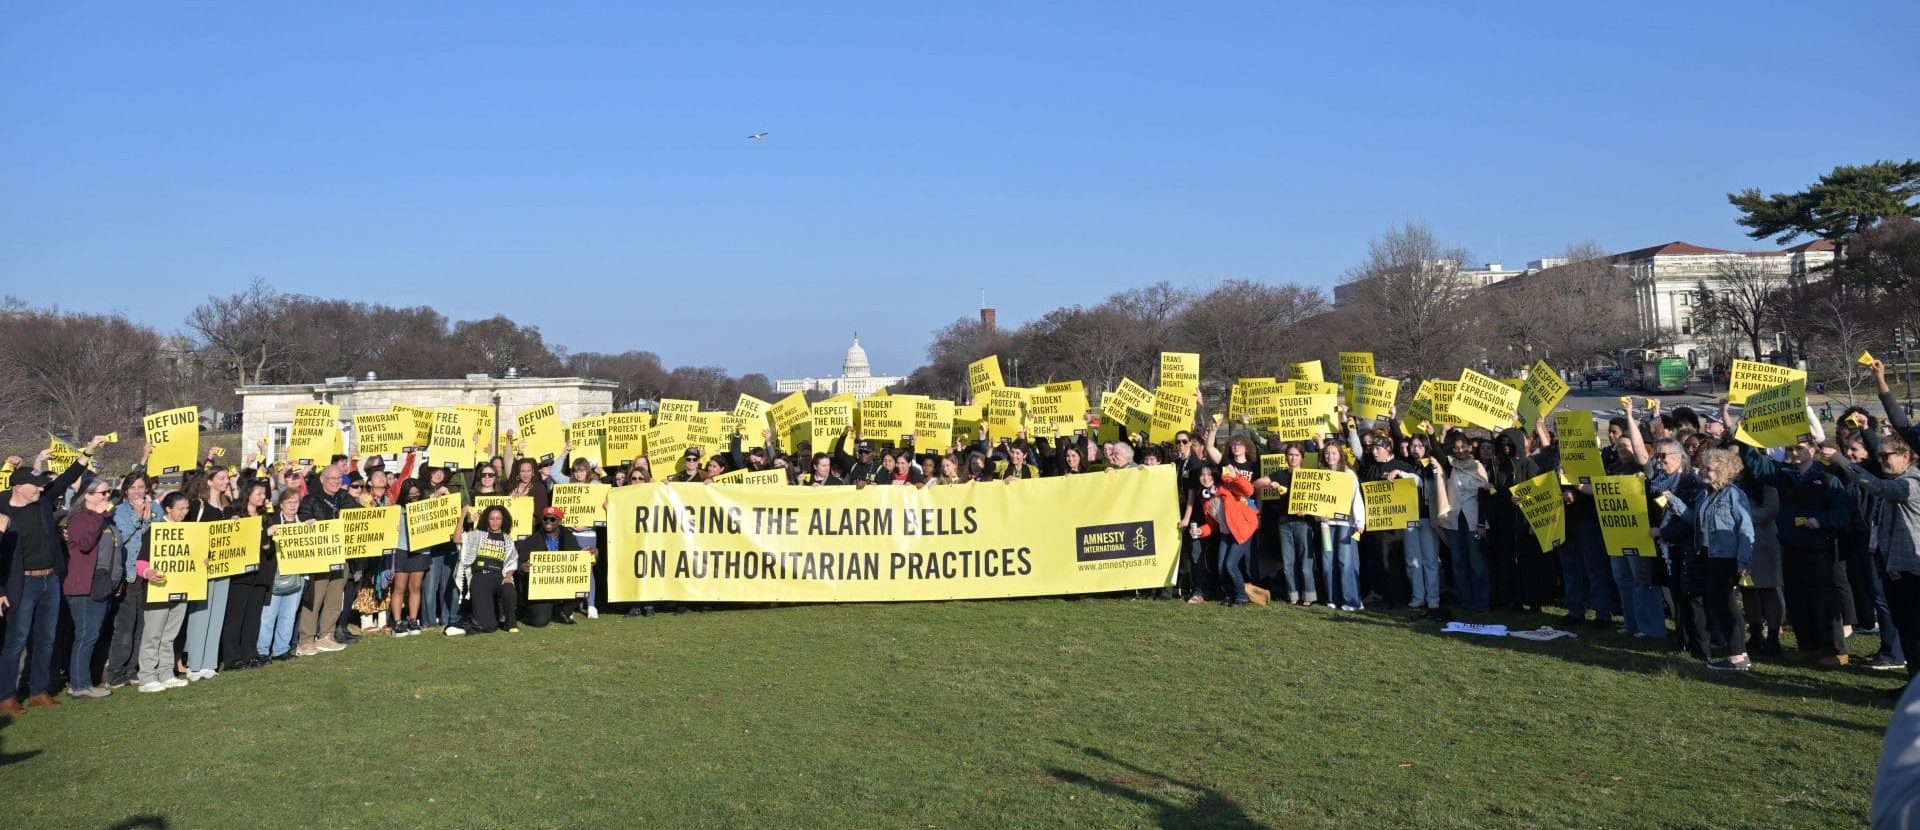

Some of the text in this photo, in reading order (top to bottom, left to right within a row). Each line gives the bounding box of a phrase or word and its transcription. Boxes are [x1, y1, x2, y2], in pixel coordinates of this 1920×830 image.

[971, 364, 984, 374] FREE
[1736, 362, 1777, 373] FREEDOM
[972, 372, 990, 385] LEQAA
[1534, 366, 1562, 393] RESPECT
[1736, 372, 1789, 383] EXPRESSION
[1465, 372, 1509, 396] FREEDOM OF
[991, 390, 1021, 399] PEACEFUL
[1123, 380, 1152, 403] WOMEN'S
[1461, 383, 1514, 410] EXPRESSION IS
[1540, 388, 1555, 404] RULE
[1747, 385, 1791, 406] FREEDOM OF
[990, 399, 1016, 407] PROTEST
[1032, 396, 1062, 404] STUDENT
[1119, 390, 1140, 407] RIGHTS
[1158, 391, 1188, 406] PEACEFUL
[1249, 397, 1270, 405] RIGHTS
[1280, 397, 1312, 406] STUDENT
[1371, 399, 1391, 408] RIGHT
[662, 403, 693, 412] RESPECT
[740, 399, 759, 409] FREE
[1156, 400, 1183, 414] PROTEST
[1435, 403, 1448, 411] ARE
[1463, 396, 1513, 421] HUMAN RIGHT
[1744, 398, 1802, 420] EXPRESSION IS
[296, 409, 330, 417] PEACEFUL
[814, 407, 847, 415] RESPECT
[1033, 406, 1058, 414] RIGHTS
[1113, 398, 1124, 409] ARE
[1126, 407, 1148, 424] HUMAN
[1281, 408, 1307, 417] RIGHTS
[357, 414, 399, 423] IMMIGRANT
[436, 412, 458, 423] FREE
[519, 406, 554, 426] DEFUND
[660, 413, 672, 421] THE
[690, 416, 707, 424] TRANS
[916, 412, 938, 420] RIGHTS
[1110, 407, 1129, 424] RIGHTS
[1160, 412, 1181, 424] HUMAN
[1435, 413, 1462, 424] RIGHTS
[147, 412, 194, 430] DEFUND
[573, 420, 605, 429] RESPECT
[814, 417, 849, 426] THE RULE
[879, 420, 902, 428] HUMAN
[929, 422, 950, 430] HUMAN
[1153, 419, 1171, 430] RIGHT
[1282, 418, 1325, 428] ARE HUMAN
[1752, 412, 1805, 432] HUMAN RIGHT
[359, 424, 386, 433] RIGHTS
[435, 425, 461, 435] LEQAA
[521, 425, 536, 438] ICE
[688, 425, 708, 434] RIGHTS
[814, 428, 842, 436] OF LAW
[150, 431, 169, 444] ICE
[361, 432, 403, 442] ARE HUMAN
[648, 430, 660, 439] STOP
[1283, 430, 1309, 438] RIGHTS
[291, 438, 311, 446] RIGHT
[433, 437, 465, 448] KORDIA
[585, 438, 600, 446] LAW
[361, 444, 388, 453] RIGHTS
[650, 444, 687, 456] DEPORTATION
[651, 456, 676, 465] MACHINE
[1295, 472, 1331, 481] WOMEN'S
[556, 486, 590, 494] WOMEN'S
[1294, 482, 1320, 490] RIGHTS
[1365, 483, 1395, 494] STUDENT
[1518, 486, 1531, 496] STOP
[1595, 482, 1621, 495] FREE
[555, 496, 581, 504] RIGHTS
[1292, 492, 1336, 504] ARE HUMAN
[1368, 495, 1391, 504] RIGHTS
[1534, 490, 1552, 502] MASS
[409, 498, 449, 514] FREEDOM OF
[570, 506, 596, 514] HUMAN
[1291, 503, 1318, 512] RIGHTS
[1368, 505, 1406, 516] ARE HUMAN
[1597, 499, 1629, 512] LEQAA
[343, 510, 387, 520] IMMIGRANT
[410, 508, 458, 525] EXPRESSION IS
[635, 505, 978, 535] RINGING THE ALARM BELLS
[417, 517, 460, 534] HUMAN RIGHT
[1369, 518, 1393, 528] RIGHTS
[1601, 515, 1638, 528] KORDIA
[155, 529, 184, 540] FREE
[279, 523, 330, 536] FREEDOM OF
[279, 534, 340, 548] EXPRESSION IS
[358, 532, 384, 542] HUMAN
[1083, 531, 1125, 545] AMNESTY
[154, 544, 190, 557] LEQAA
[219, 547, 246, 560] HUMAN
[288, 546, 342, 559] HUMAN RIGHT
[1084, 544, 1126, 554] INTERNATIONAL
[533, 554, 567, 562] FREEDOM
[154, 560, 195, 573] KORDIA
[634, 547, 1031, 580] ON AUTHORITARIAN PRACTICES
[1078, 558, 1157, 572] www.amnestyusa.org
[533, 565, 577, 573] EXPRESSION
[539, 576, 588, 584] HUMAN RIGHT
